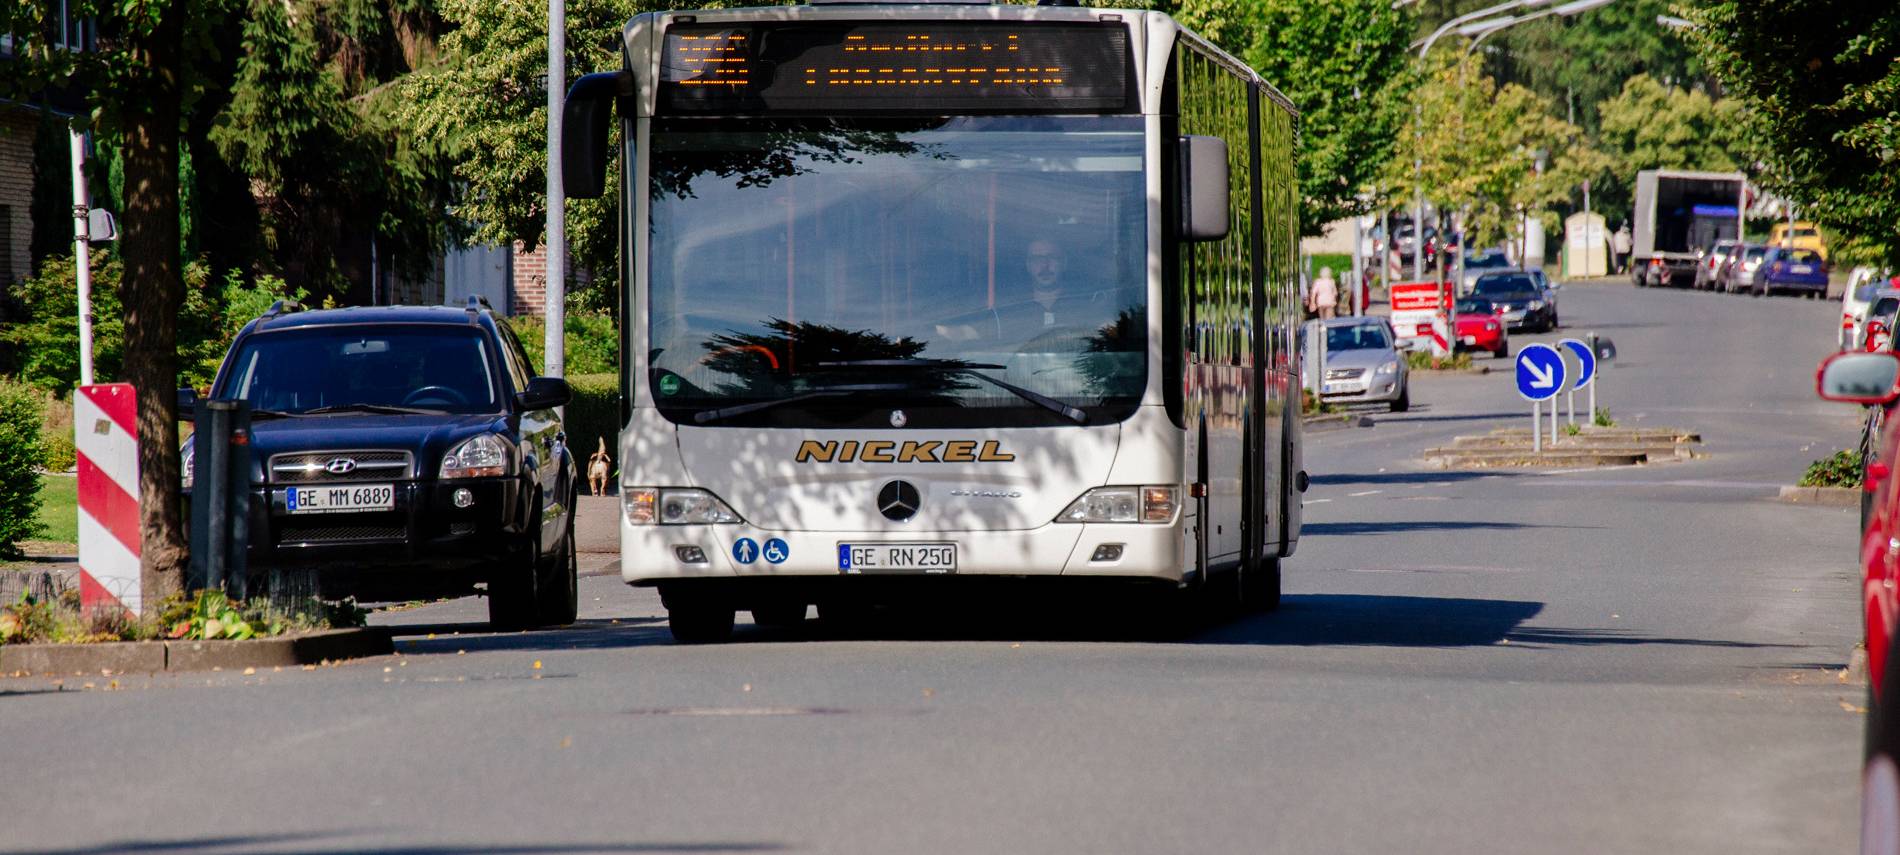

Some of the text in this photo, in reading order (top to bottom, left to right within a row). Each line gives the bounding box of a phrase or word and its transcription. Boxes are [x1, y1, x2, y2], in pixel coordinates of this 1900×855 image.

[795, 440, 1015, 462] NICKEL
[298, 488, 391, 506] GE MM 6889
[852, 548, 952, 566] GE RN 250
